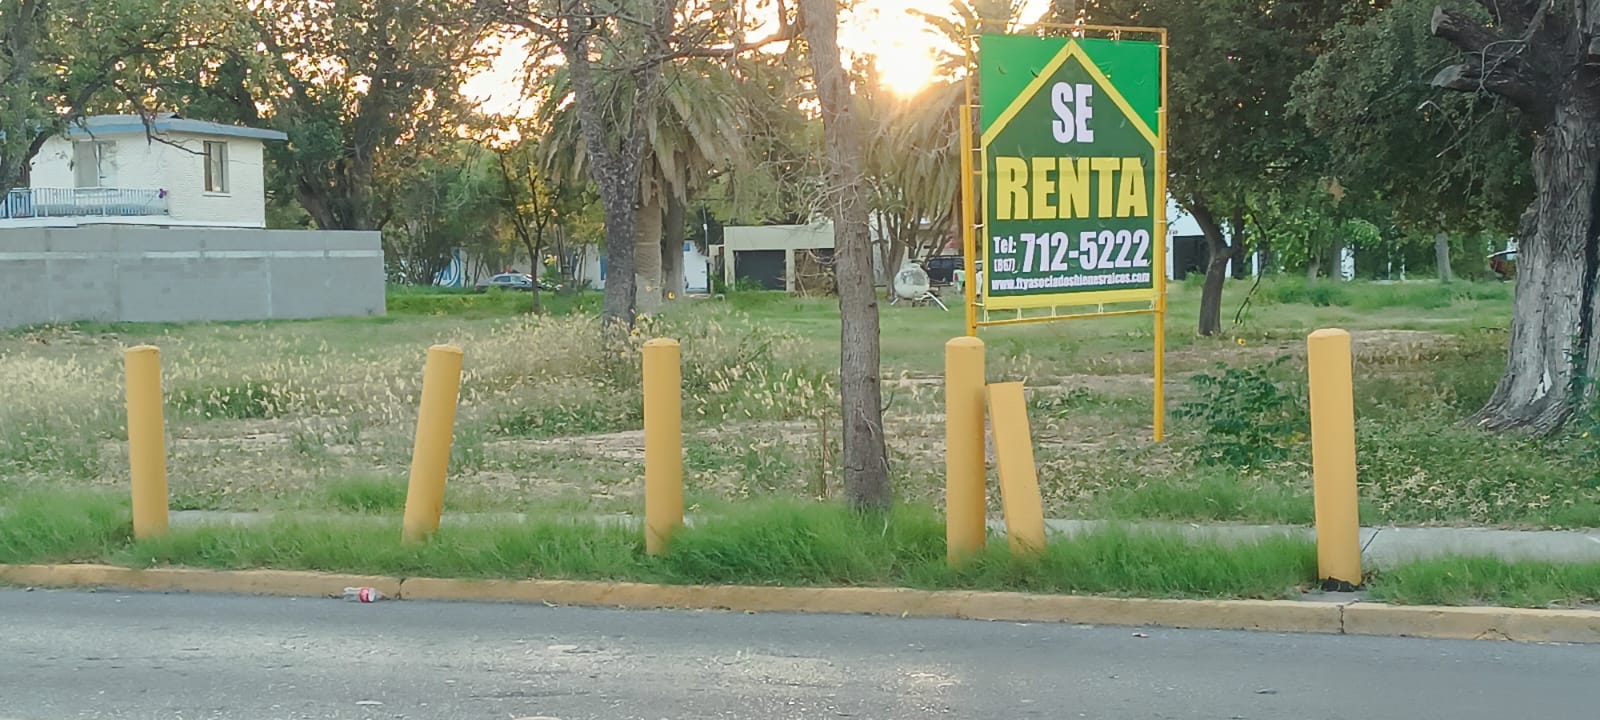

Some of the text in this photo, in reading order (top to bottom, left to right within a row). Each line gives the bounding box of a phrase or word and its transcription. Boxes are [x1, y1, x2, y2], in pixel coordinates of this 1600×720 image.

[1051, 82, 1094, 143] SE
[995, 156, 1148, 220] RENTA
[993, 229, 1150, 273] Tel: 712-5222
